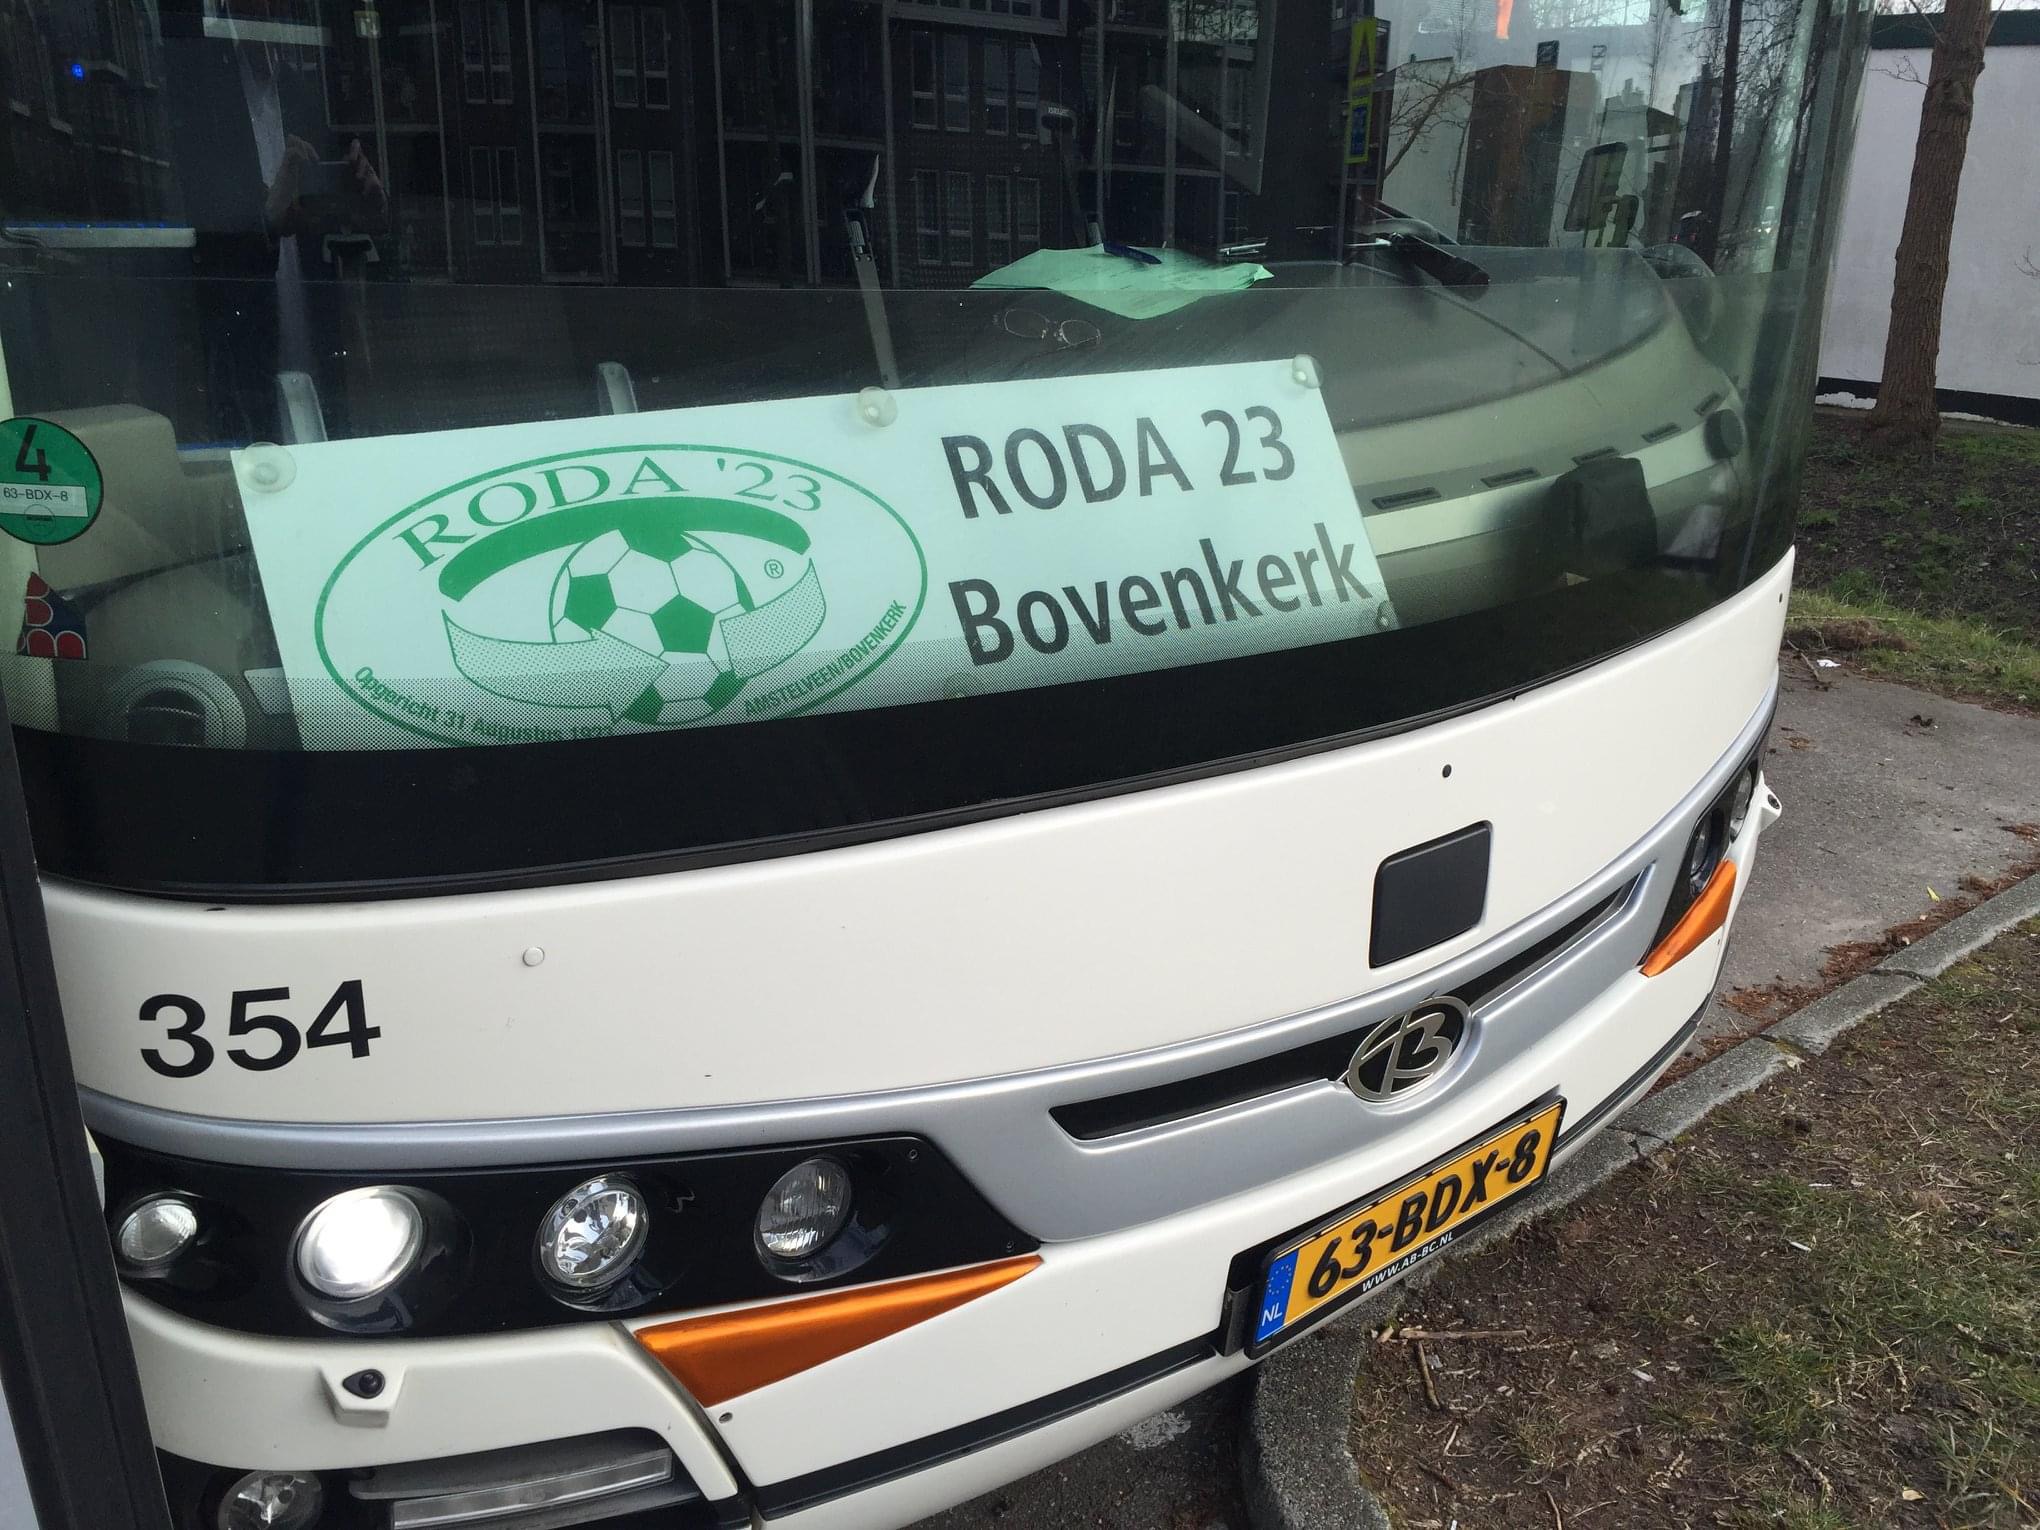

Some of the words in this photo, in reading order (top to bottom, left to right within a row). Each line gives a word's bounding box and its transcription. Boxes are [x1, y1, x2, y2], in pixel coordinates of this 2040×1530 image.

[3, 486, 69, 502] 63-BDX-8
[15, 424, 51, 482] 4
[940, 416, 1194, 520] RODA
[1200, 404, 1296, 488] 23
[392, 456, 690, 571] RODA
[716, 457, 823, 512] '23
[948, 521, 1374, 667] Bovenkerk
[354, 665, 439, 723] Opgericht
[444, 709, 466, 730] 31
[471, 716, 562, 743] Augustus
[743, 599, 907, 717] AMSTELVEEN/BOVENKERK
[138, 978, 381, 1079] 354
[1261, 1301, 1283, 1327] NL
[1307, 1129, 1541, 1299] 63-BDX-8
[1362, 1231, 1454, 1292] WWW.AB-BC.NL
